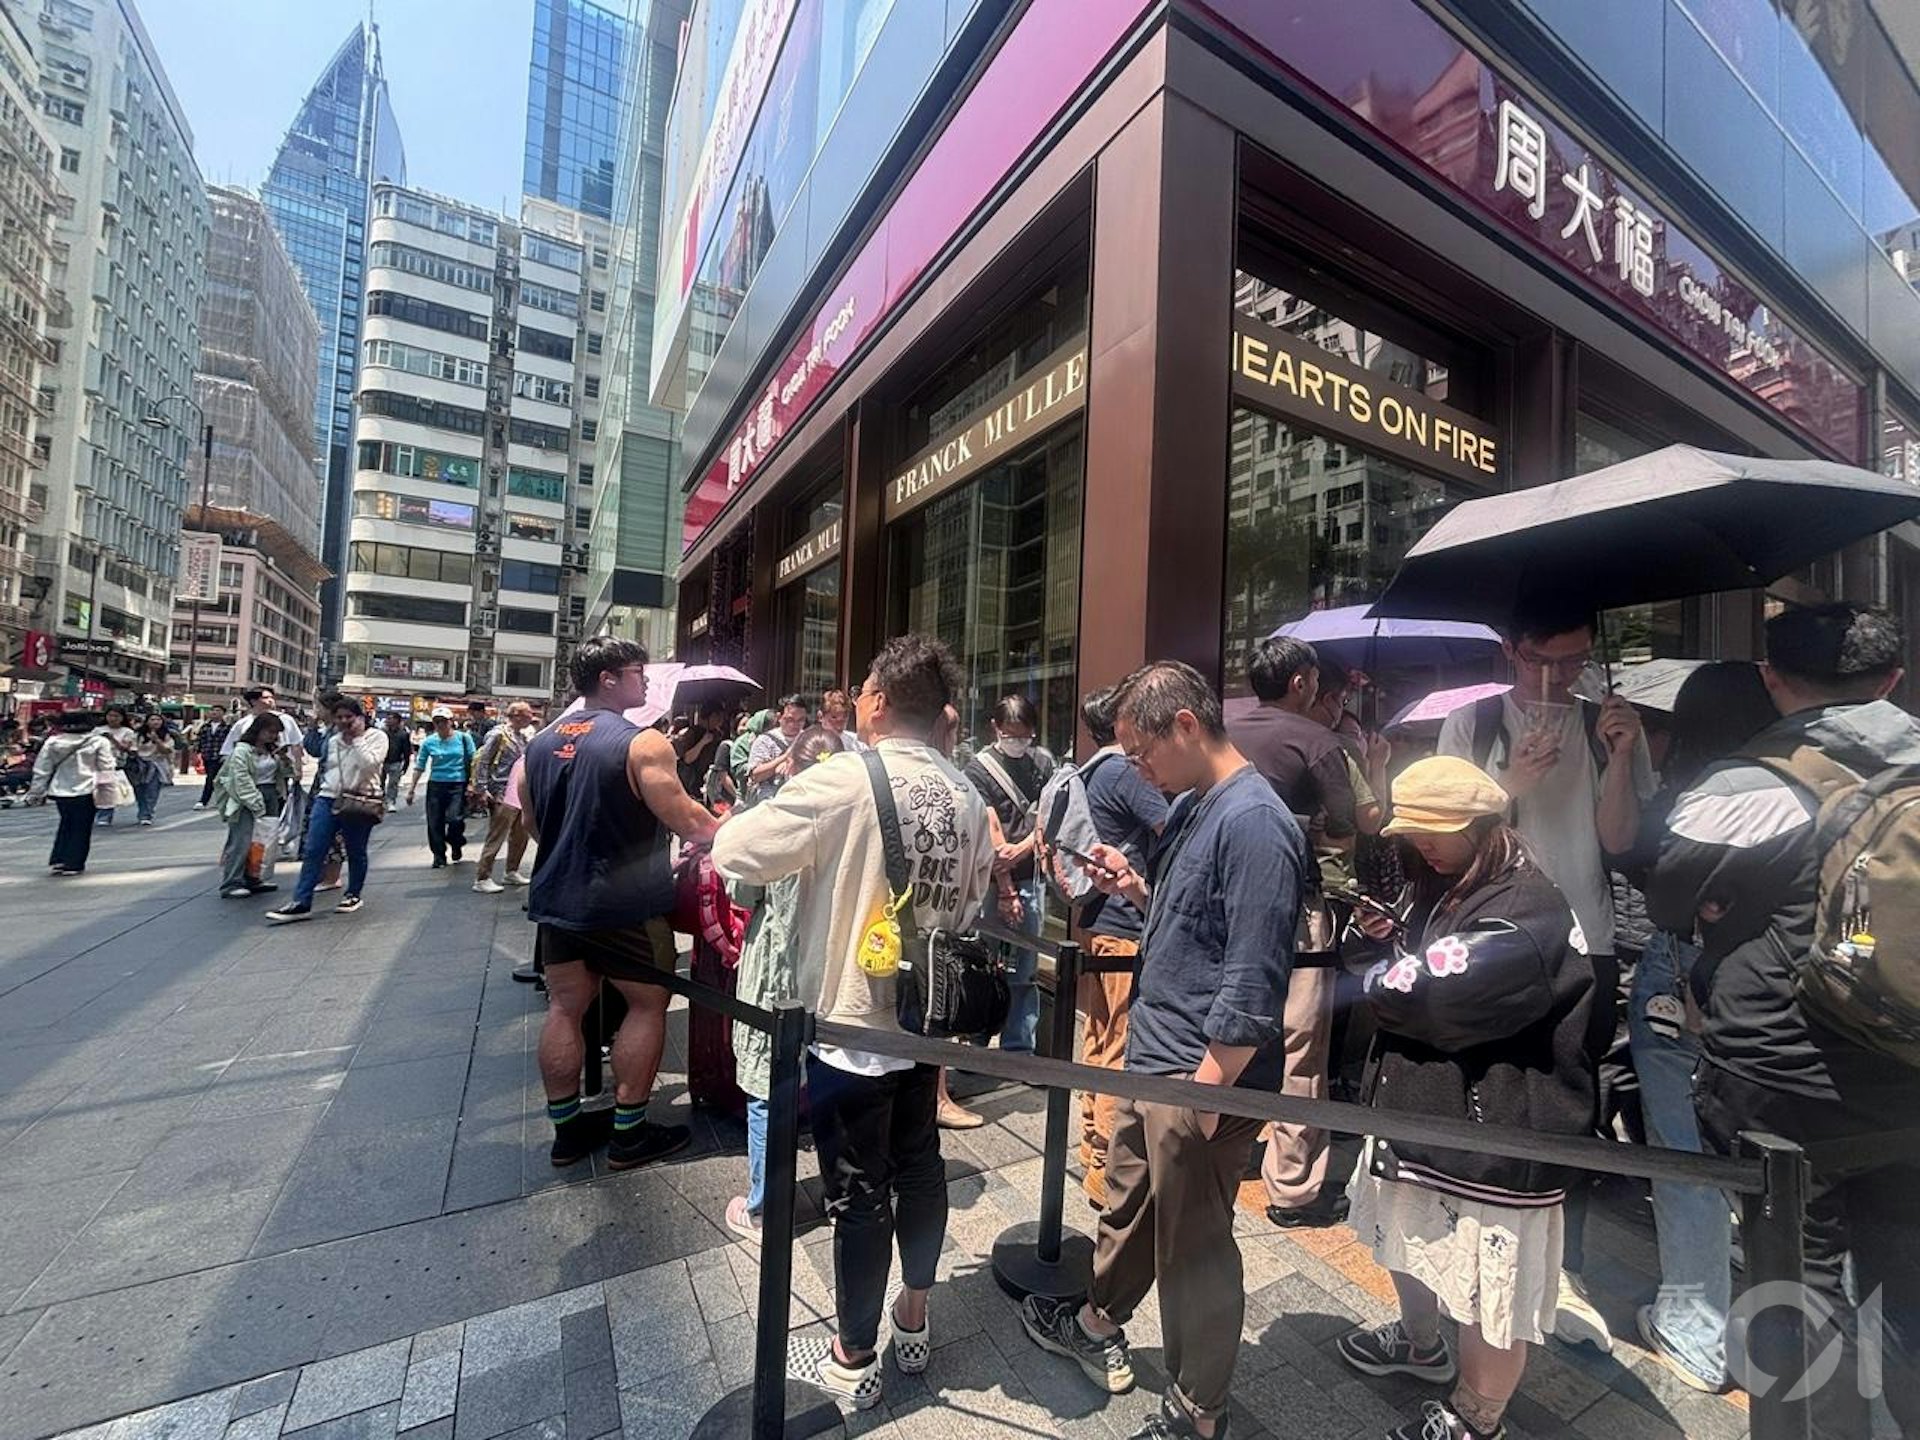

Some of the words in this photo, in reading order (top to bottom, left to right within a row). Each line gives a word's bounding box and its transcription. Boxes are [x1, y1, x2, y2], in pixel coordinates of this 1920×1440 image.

[1494, 99, 1654, 297] 周大福
[1233, 331, 1372, 423] EARTS
[1379, 396, 1427, 447] ON
[1434, 417, 1497, 474] FIRE
[895, 429, 973, 505] FRANCK
[779, 542, 814, 578] FRANCK
[918, 855, 959, 883] BIKE
